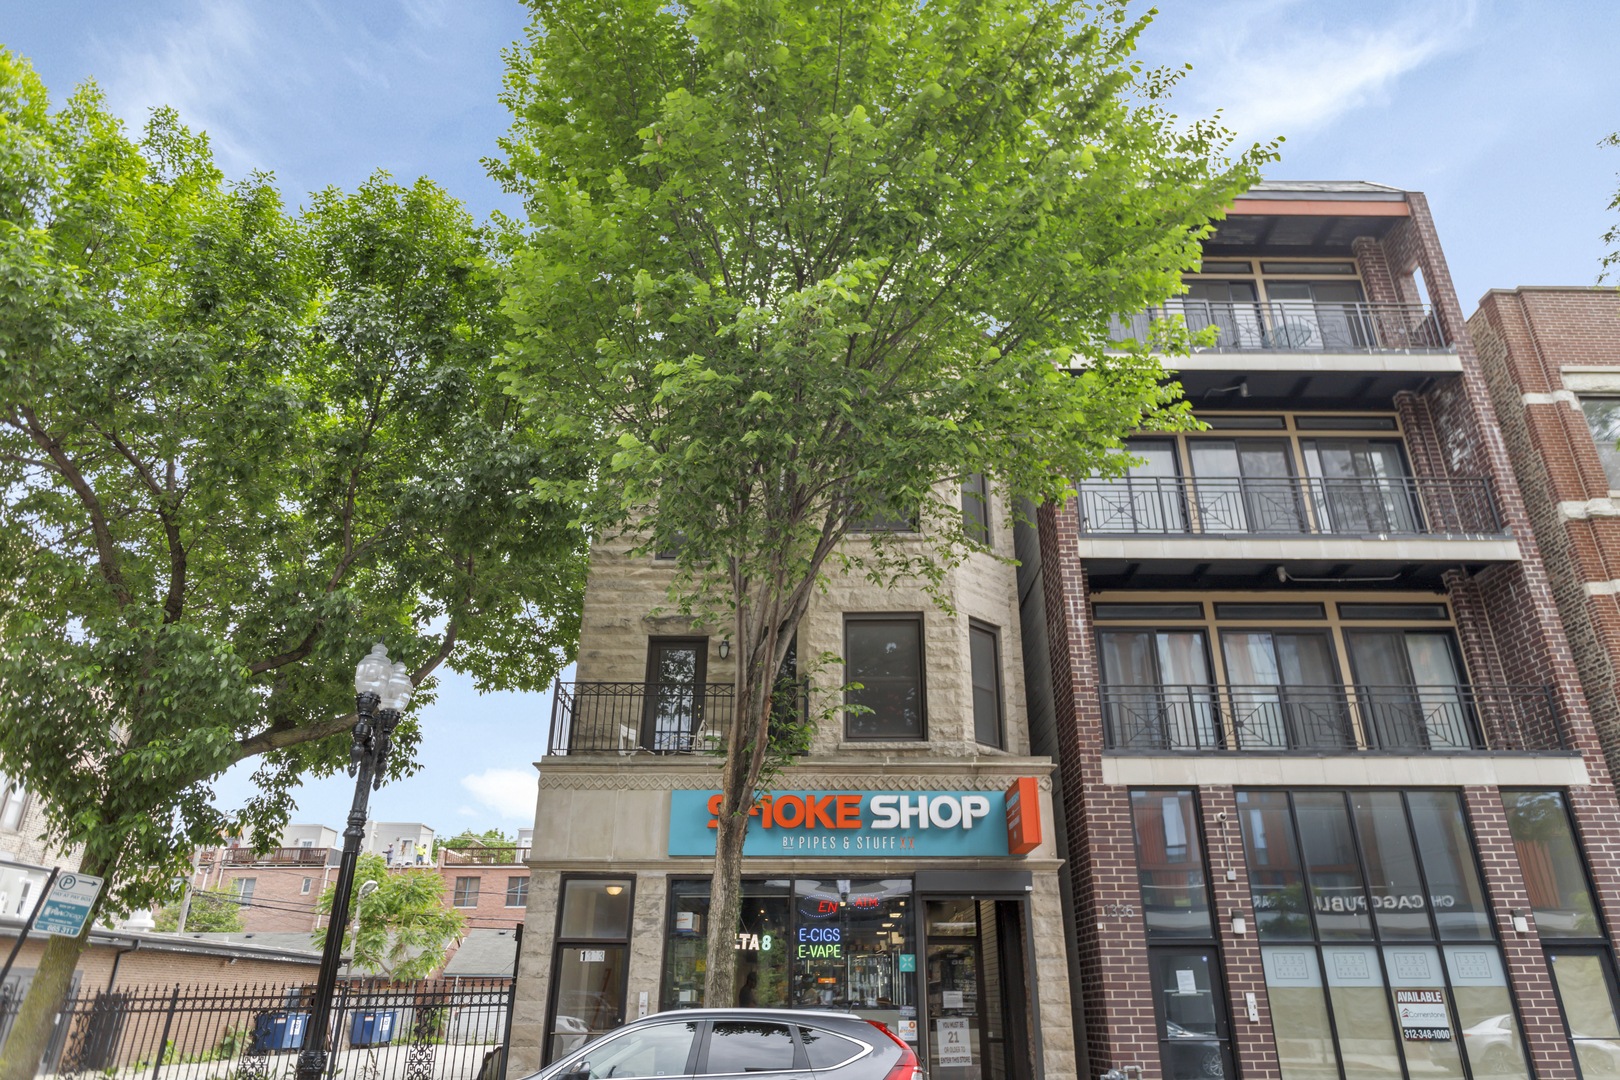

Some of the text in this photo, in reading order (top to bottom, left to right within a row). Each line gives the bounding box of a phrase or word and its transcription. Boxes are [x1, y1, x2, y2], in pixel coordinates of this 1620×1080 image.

[870, 795, 990, 829] SHOP
[782, 836, 794, 847] BY
[799, 836, 836, 850] PIPES
[843, 836, 850, 850] &
[857, 836, 896, 850] STUFF
[855, 897, 878, 907] ATM
[1104, 904, 1134, 918] 1335
[799, 928, 841, 942] E-CIGS
[798, 944, 841, 958] E-VAPE
[1275, 956, 1304, 964] 1335
[1336, 956, 1365, 964] 1335
[1396, 956, 1425, 964] 1335
[1457, 955, 1486, 964] 1335
[1397, 991, 1442, 1002] AVAILABLE
[948, 1031, 959, 1043] 21
[1404, 1029, 1450, 1039] 312-348-1000
